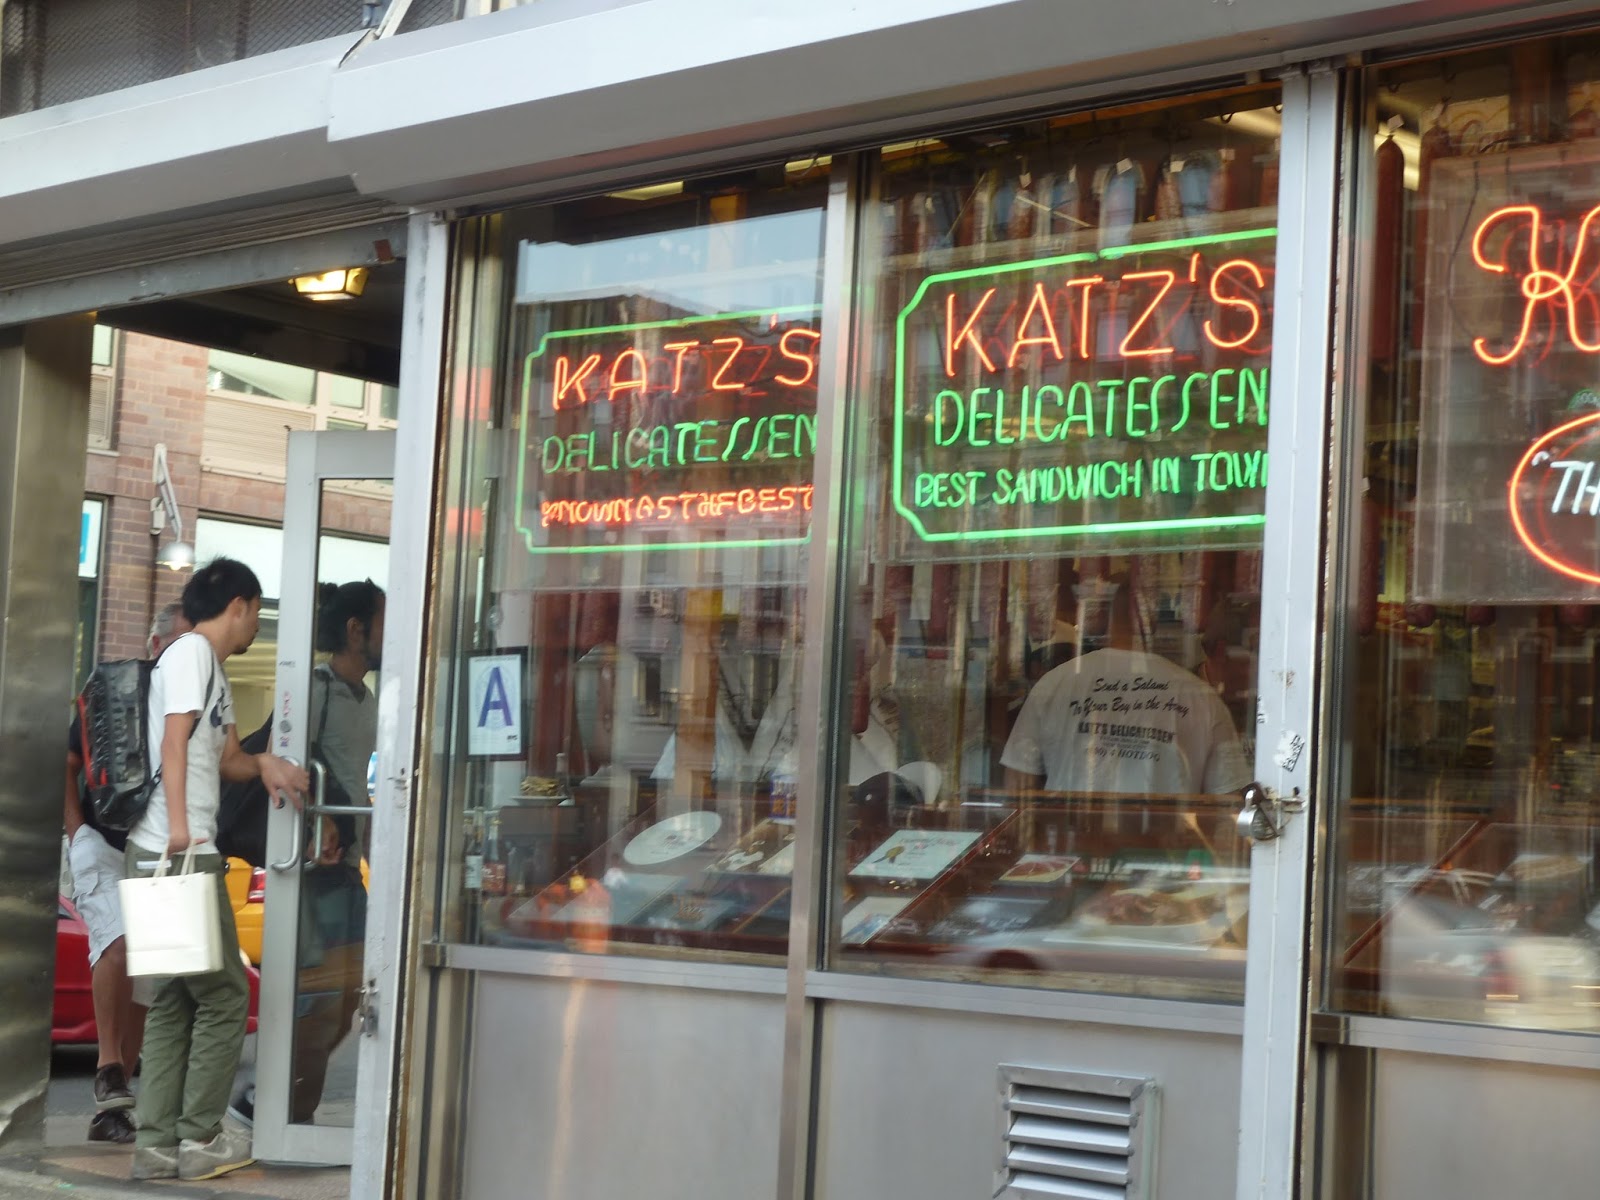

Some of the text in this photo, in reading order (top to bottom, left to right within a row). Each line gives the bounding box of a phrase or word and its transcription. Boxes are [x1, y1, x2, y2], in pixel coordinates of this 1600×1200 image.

[945, 252, 1265, 377] KATZ'S
[552, 312, 820, 411] KATZ'S
[934, 367, 1268, 447] DELICATESSEN
[543, 414, 818, 474] DELICATESSEN
[635, 495, 677, 520] AS
[738, 483, 815, 514] BEST
[914, 470, 987, 507] BEST
[991, 459, 1142, 505] SANDWICH
[1151, 455, 1181, 494] IN
[477, 666, 514, 728] A
[1111, 696, 1131, 715] Boy
[1132, 700, 1143, 711] in
[1145, 695, 1161, 711] the
